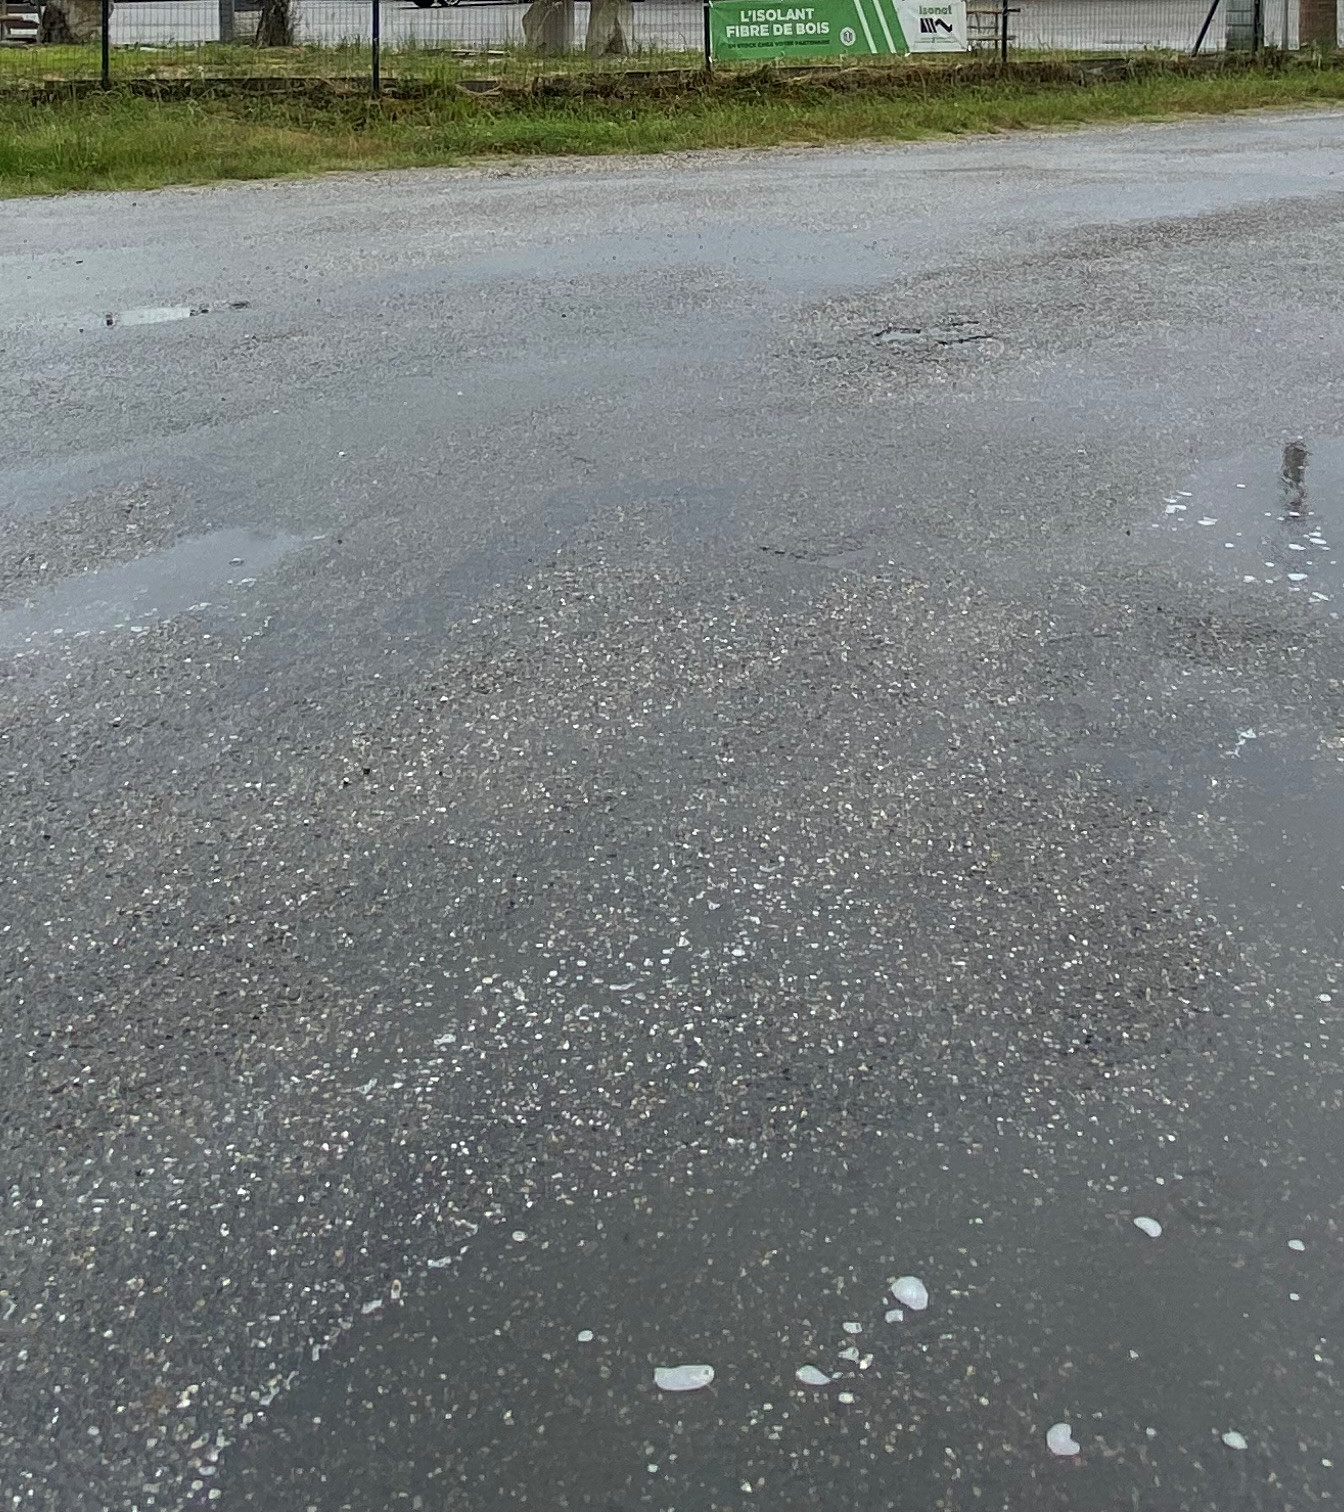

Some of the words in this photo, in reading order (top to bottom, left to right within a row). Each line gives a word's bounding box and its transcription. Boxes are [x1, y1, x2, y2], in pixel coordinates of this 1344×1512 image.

[740, 7, 815, 22] L'ISOLANT
[726, 24, 769, 38] FIBRE
[773, 23, 793, 36] DE
[796, 22, 830, 35] BOIS
